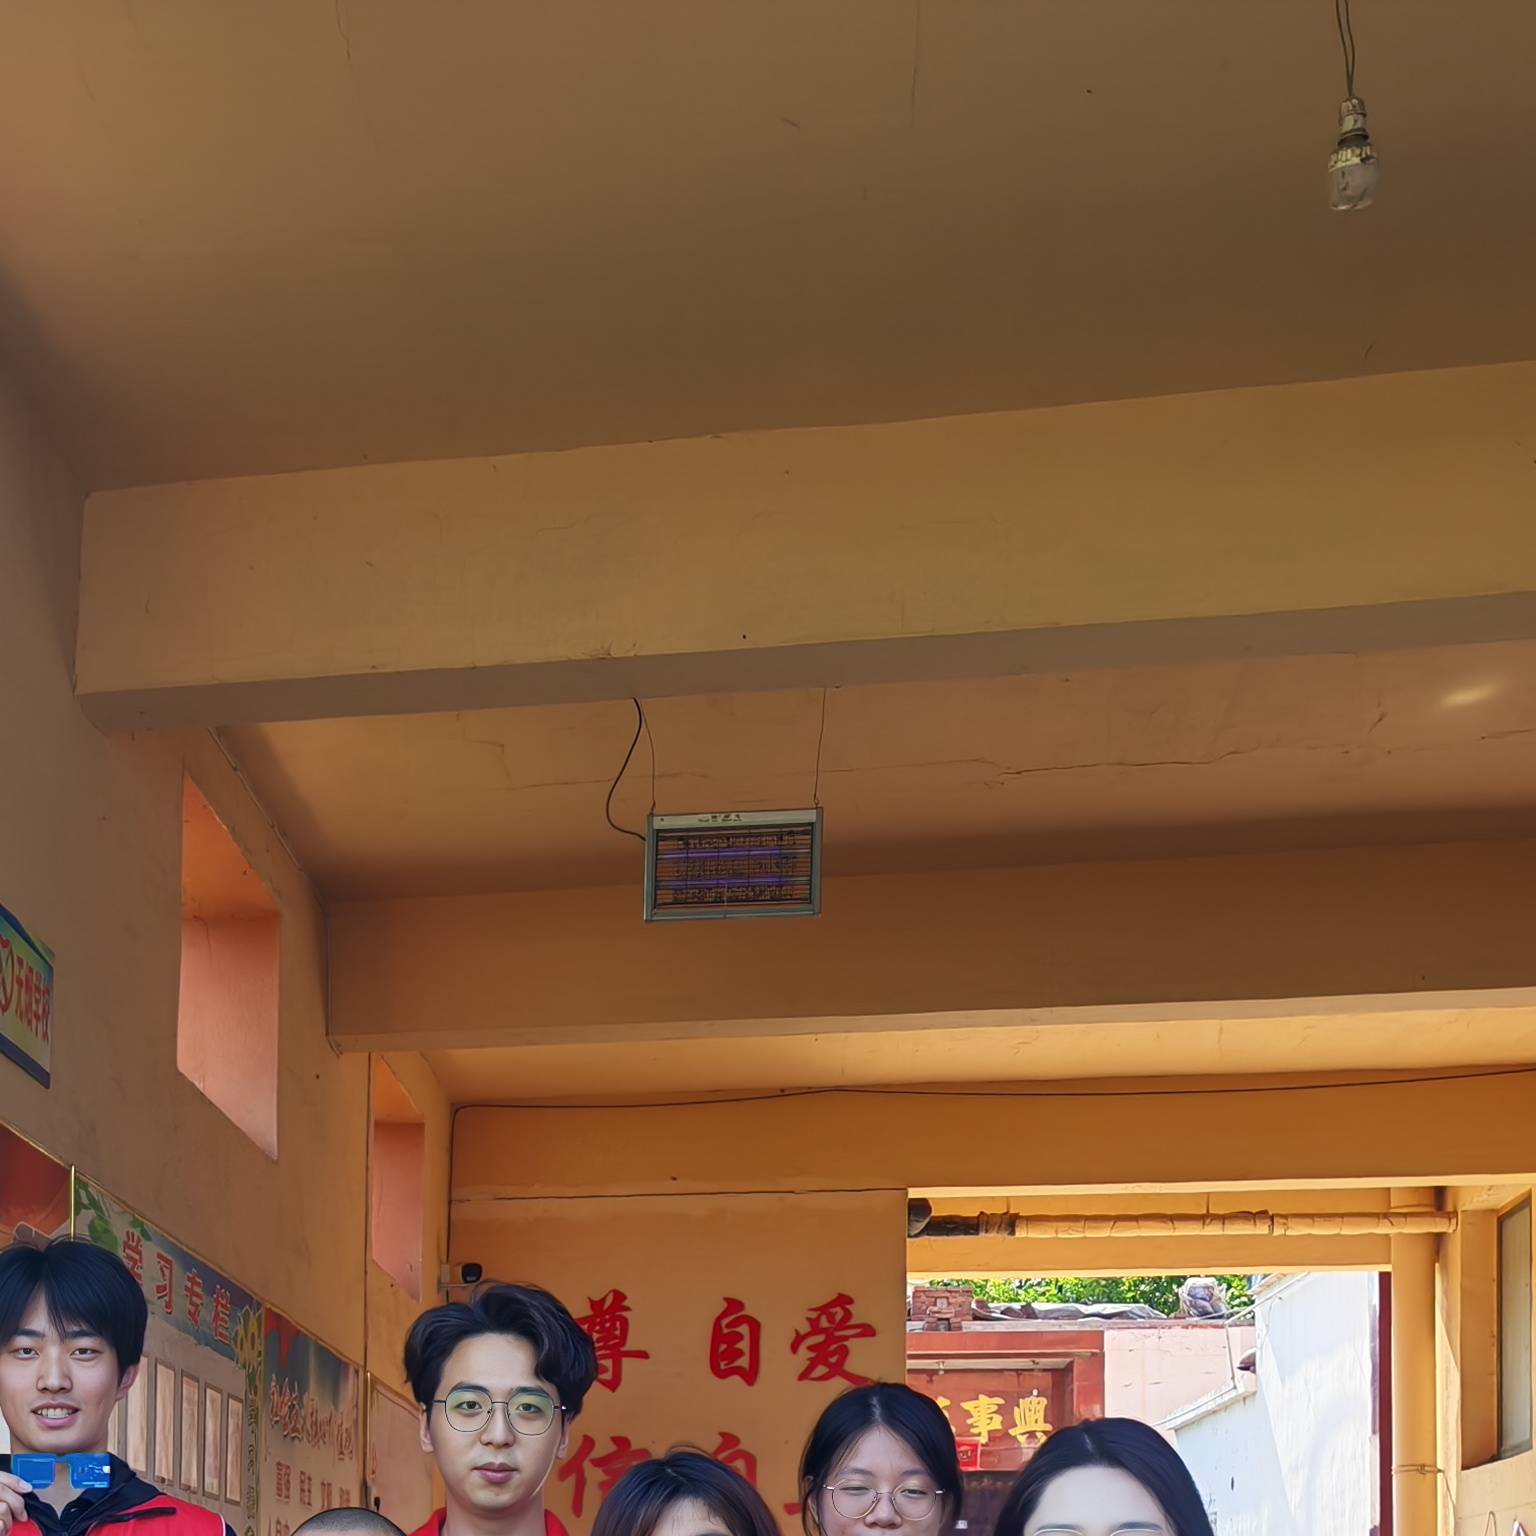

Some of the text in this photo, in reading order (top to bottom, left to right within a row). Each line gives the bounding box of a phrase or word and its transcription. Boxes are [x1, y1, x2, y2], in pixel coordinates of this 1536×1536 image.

[121, 1229, 232, 1344] 学习专栏
[708, 1293, 877, 1387] 自爱
[937, 1394, 1053, 1447] 事興
